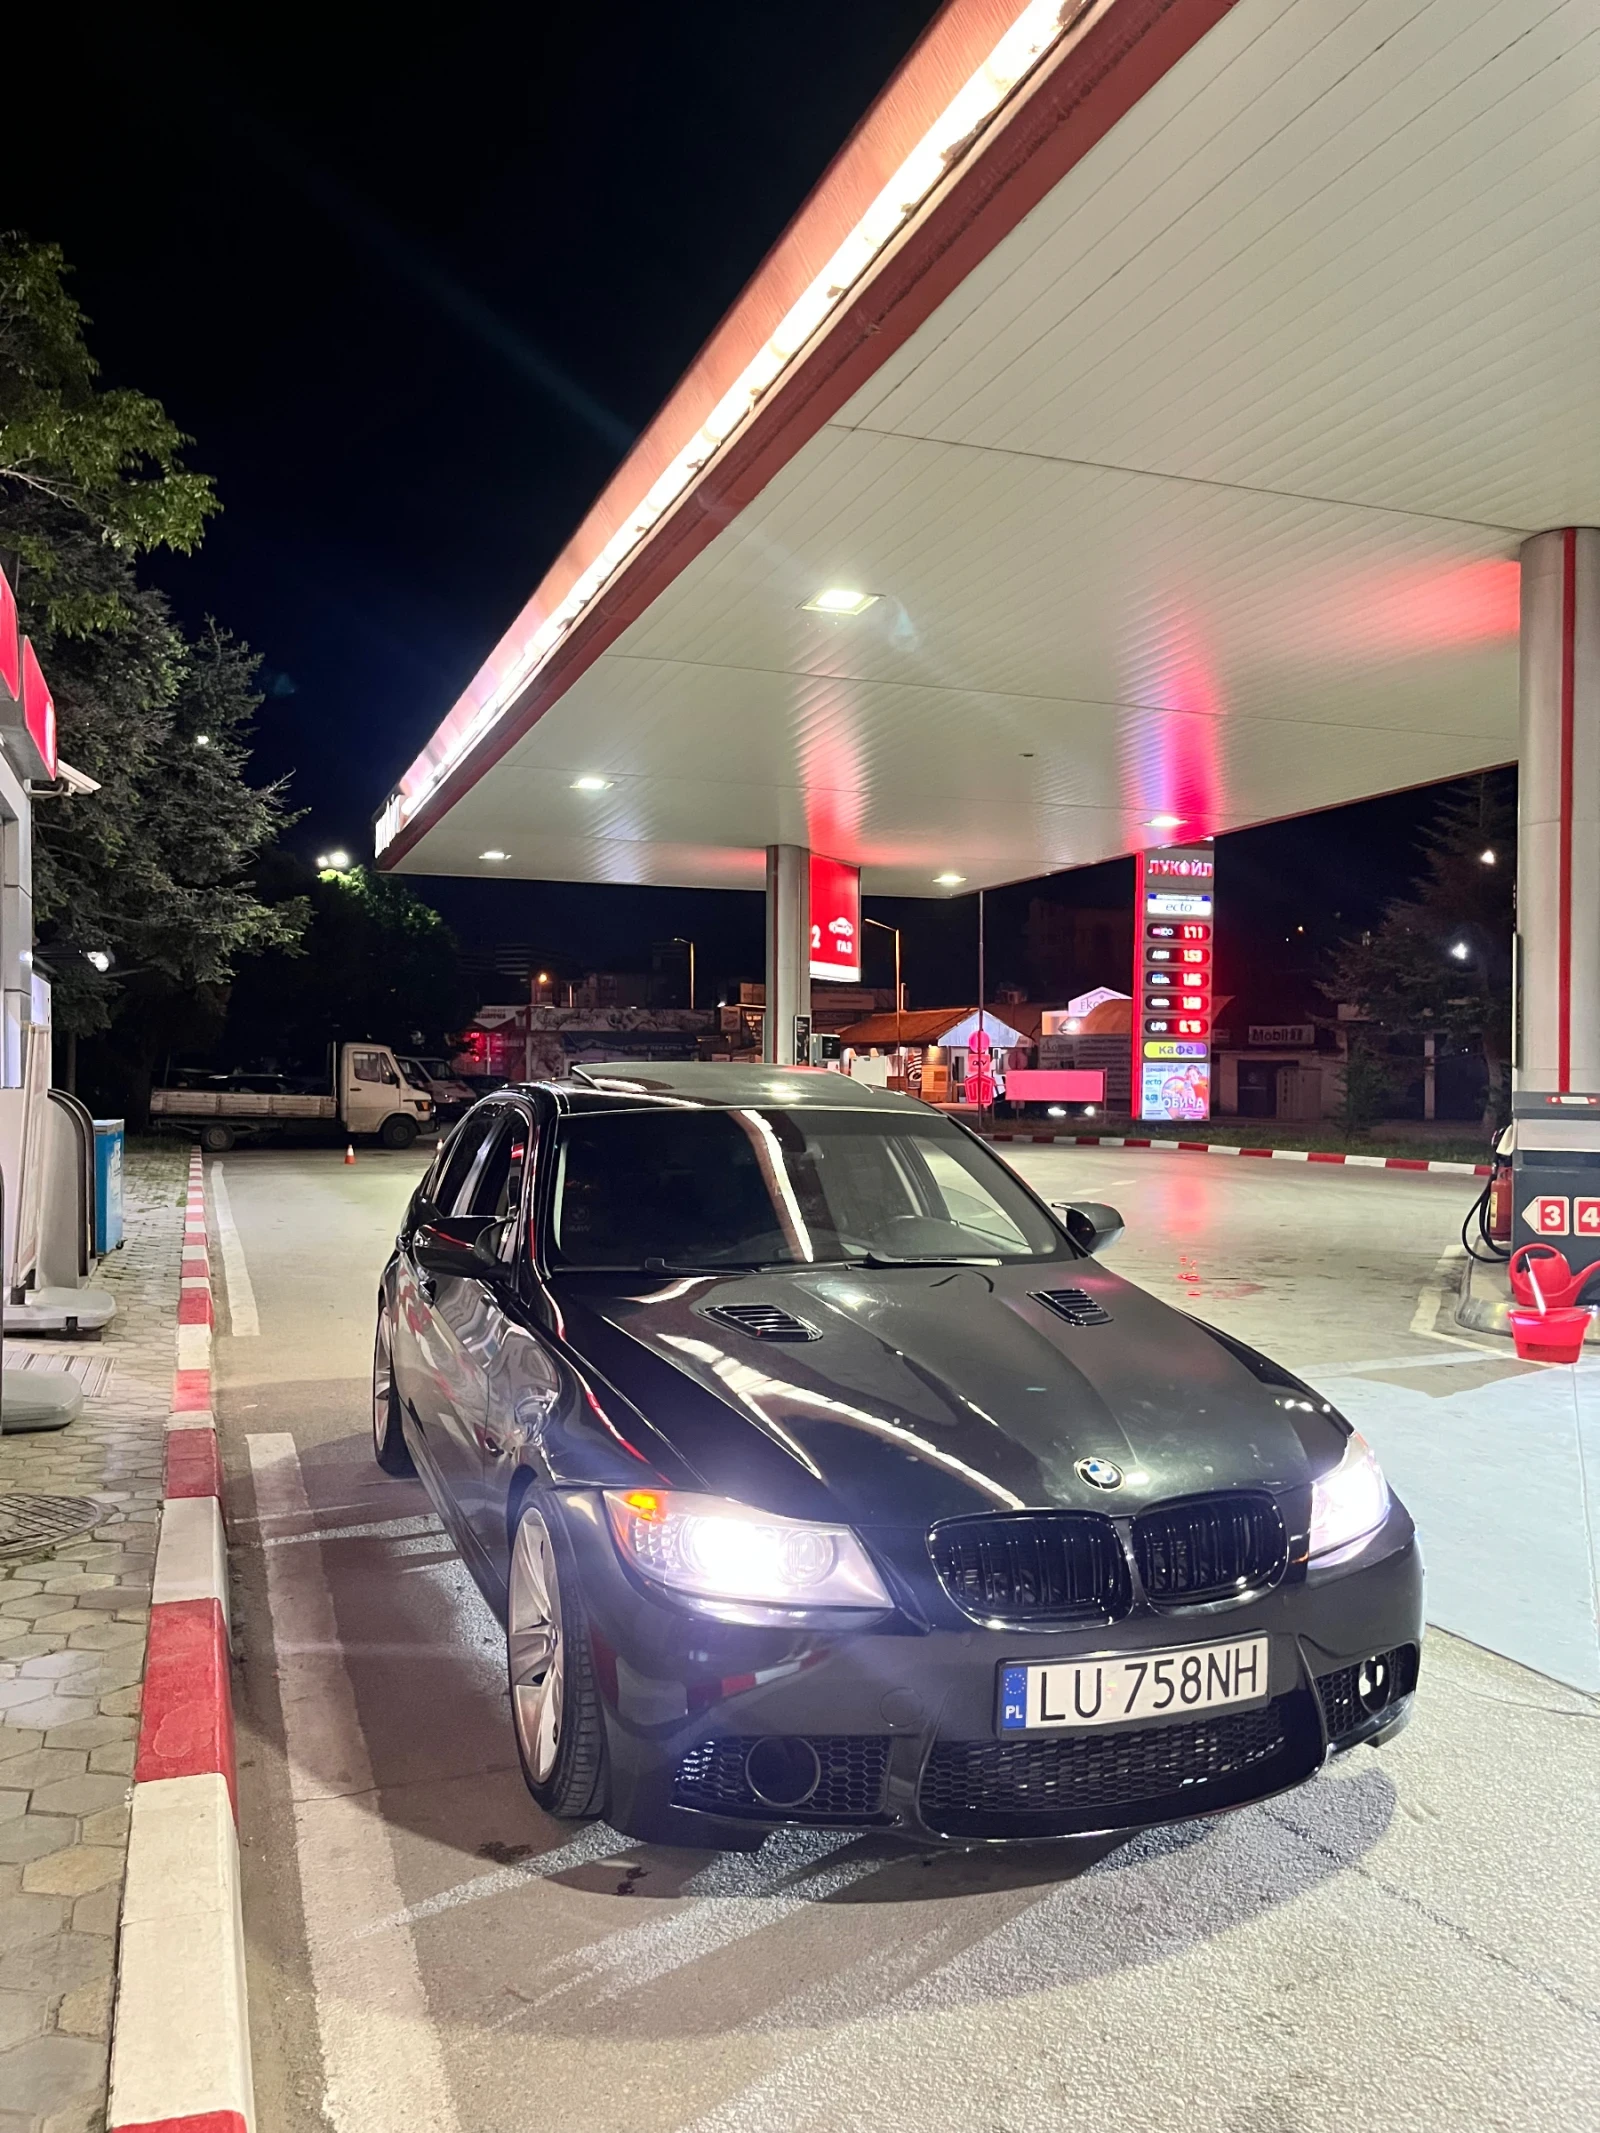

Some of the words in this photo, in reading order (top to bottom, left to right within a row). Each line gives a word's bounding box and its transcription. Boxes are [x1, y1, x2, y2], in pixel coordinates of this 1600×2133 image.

[1148, 859, 1212, 877] ЛУКОЙЛ
[1165, 902, 1192, 912] ecto
[811, 925, 821, 949] 2
[1159, 1045, 1194, 1055] кафе
[1544, 1205, 1561, 1226] 3
[1581, 1206, 1600, 1228] 4
[1040, 1668, 1102, 1721] LU
[1124, 1645, 1258, 1714] 758NH
[1005, 1705, 1023, 1719] PL
